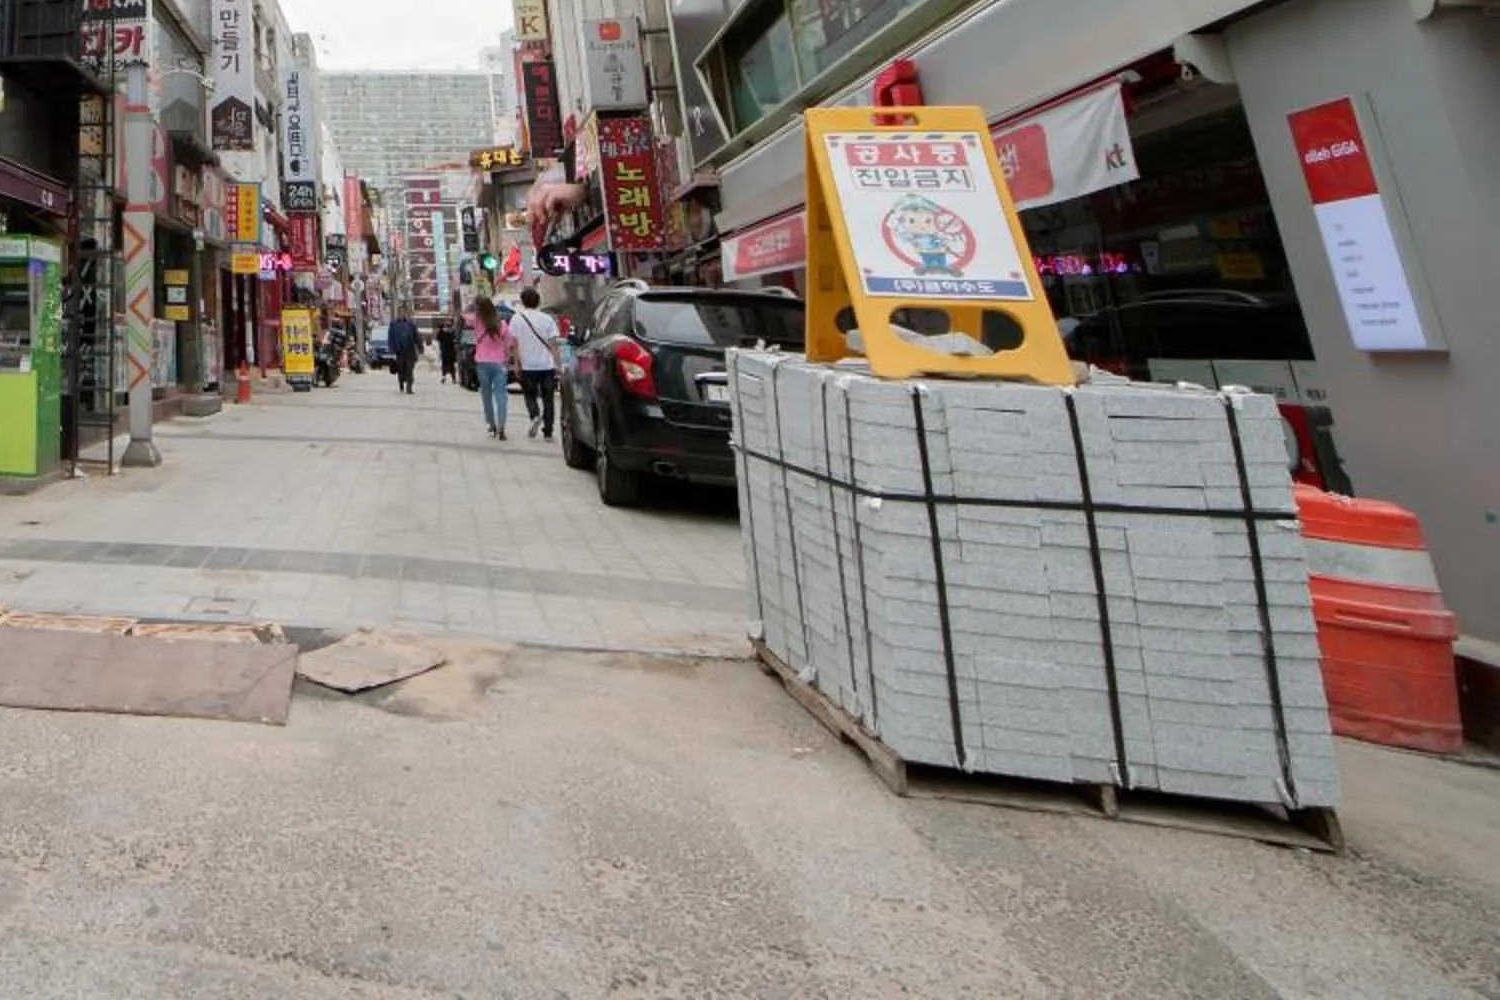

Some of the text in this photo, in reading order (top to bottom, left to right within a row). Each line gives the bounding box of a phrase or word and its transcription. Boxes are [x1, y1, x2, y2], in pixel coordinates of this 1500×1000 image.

[219, 12, 240, 74] 만들기
[856, 167, 973, 189] 진입금지
[1105, 142, 1127, 172] kt
[614, 160, 653, 237] 노래방
